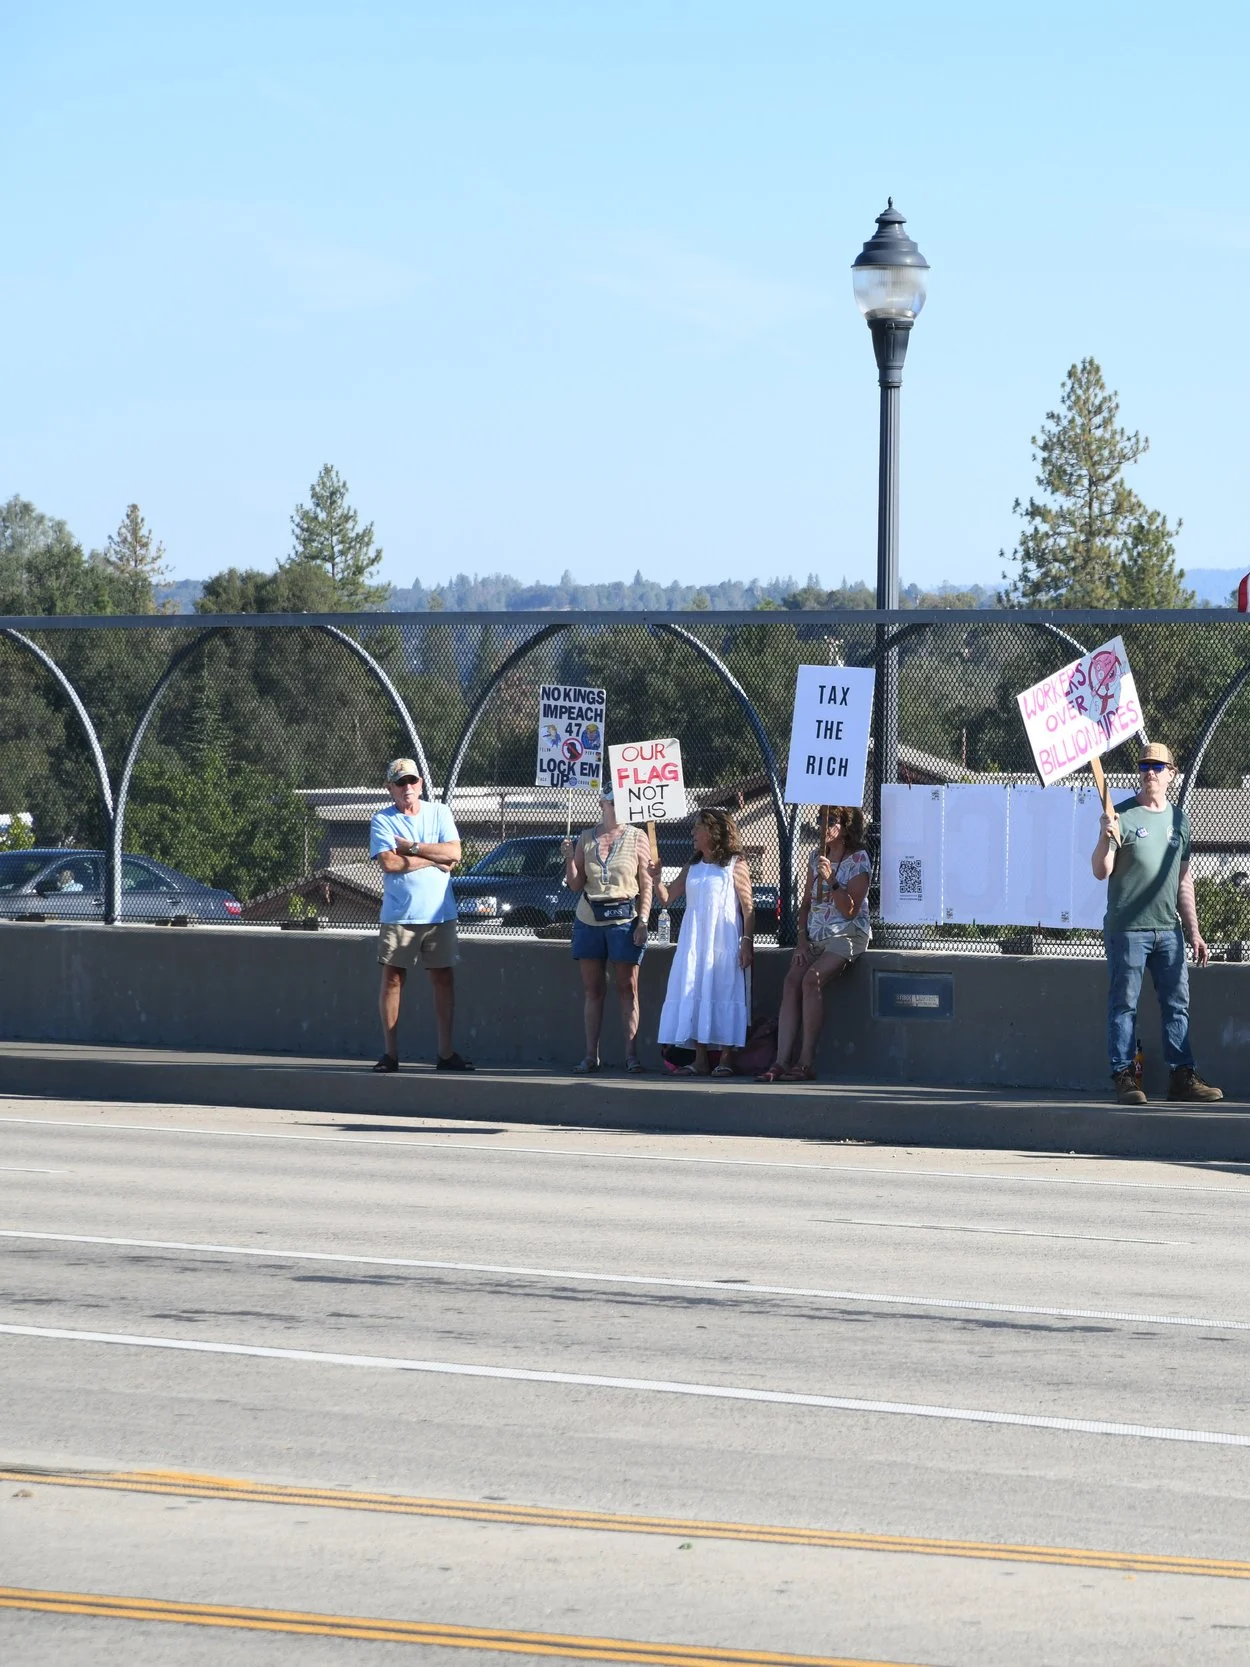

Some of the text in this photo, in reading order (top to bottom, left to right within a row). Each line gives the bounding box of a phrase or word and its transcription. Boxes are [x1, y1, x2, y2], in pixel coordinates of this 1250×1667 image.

[541, 687, 605, 705] NO KINGS
[819, 685, 850, 706] TAX
[1023, 662, 1087, 720] WORKERS
[542, 703, 604, 723] IMPEACH
[1045, 694, 1089, 733] OVER
[565, 722, 582, 738] 47
[815, 719, 844, 740] THE
[1039, 700, 1139, 776] BILLIONAIRES
[622, 743, 665, 762] OUR
[539, 758, 600, 778] LOCK EM
[617, 762, 679, 788] FLAG
[805, 755, 849, 777] RICH
[550, 773, 570, 787] UP
[628, 784, 669, 803] NOT
[629, 802, 667, 821] HIS
